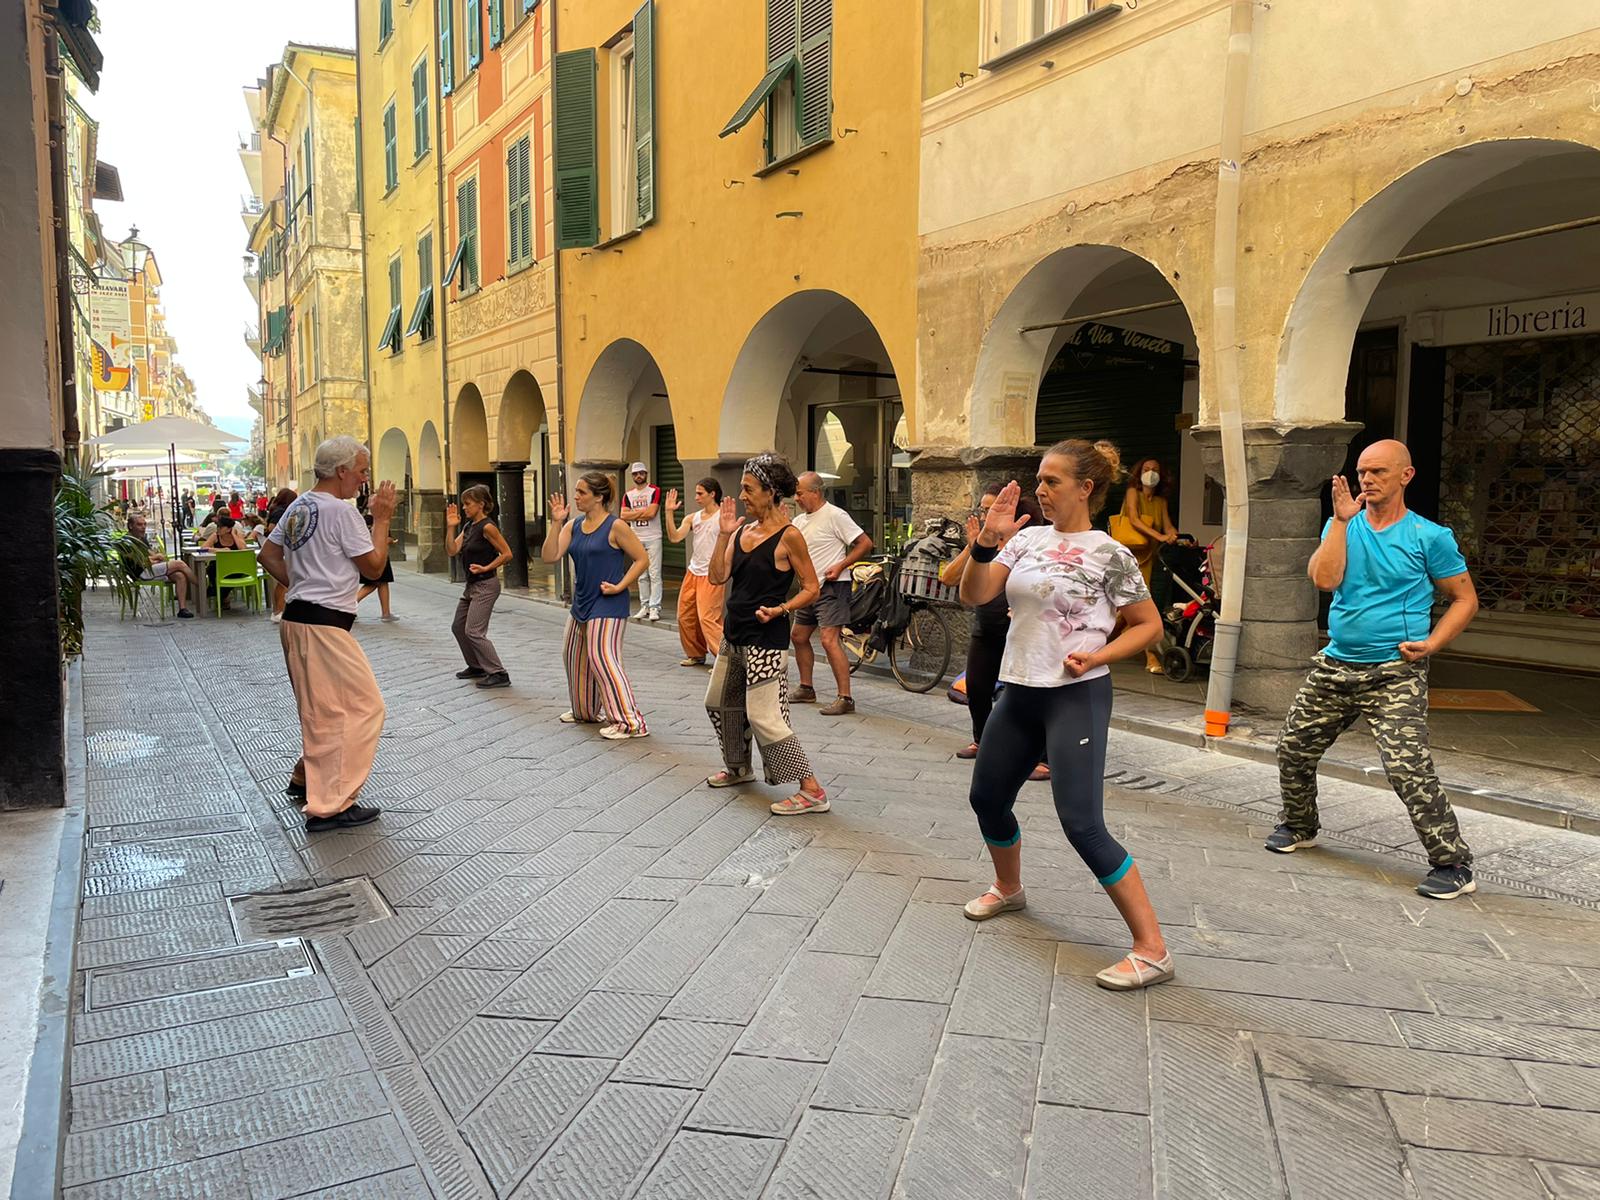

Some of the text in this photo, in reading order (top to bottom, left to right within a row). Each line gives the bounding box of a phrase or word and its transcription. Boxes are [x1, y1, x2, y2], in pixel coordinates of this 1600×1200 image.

[1487, 301, 1587, 337] libreria
[1087, 325, 1114, 344] Via
[1121, 329, 1172, 354] Veneto
